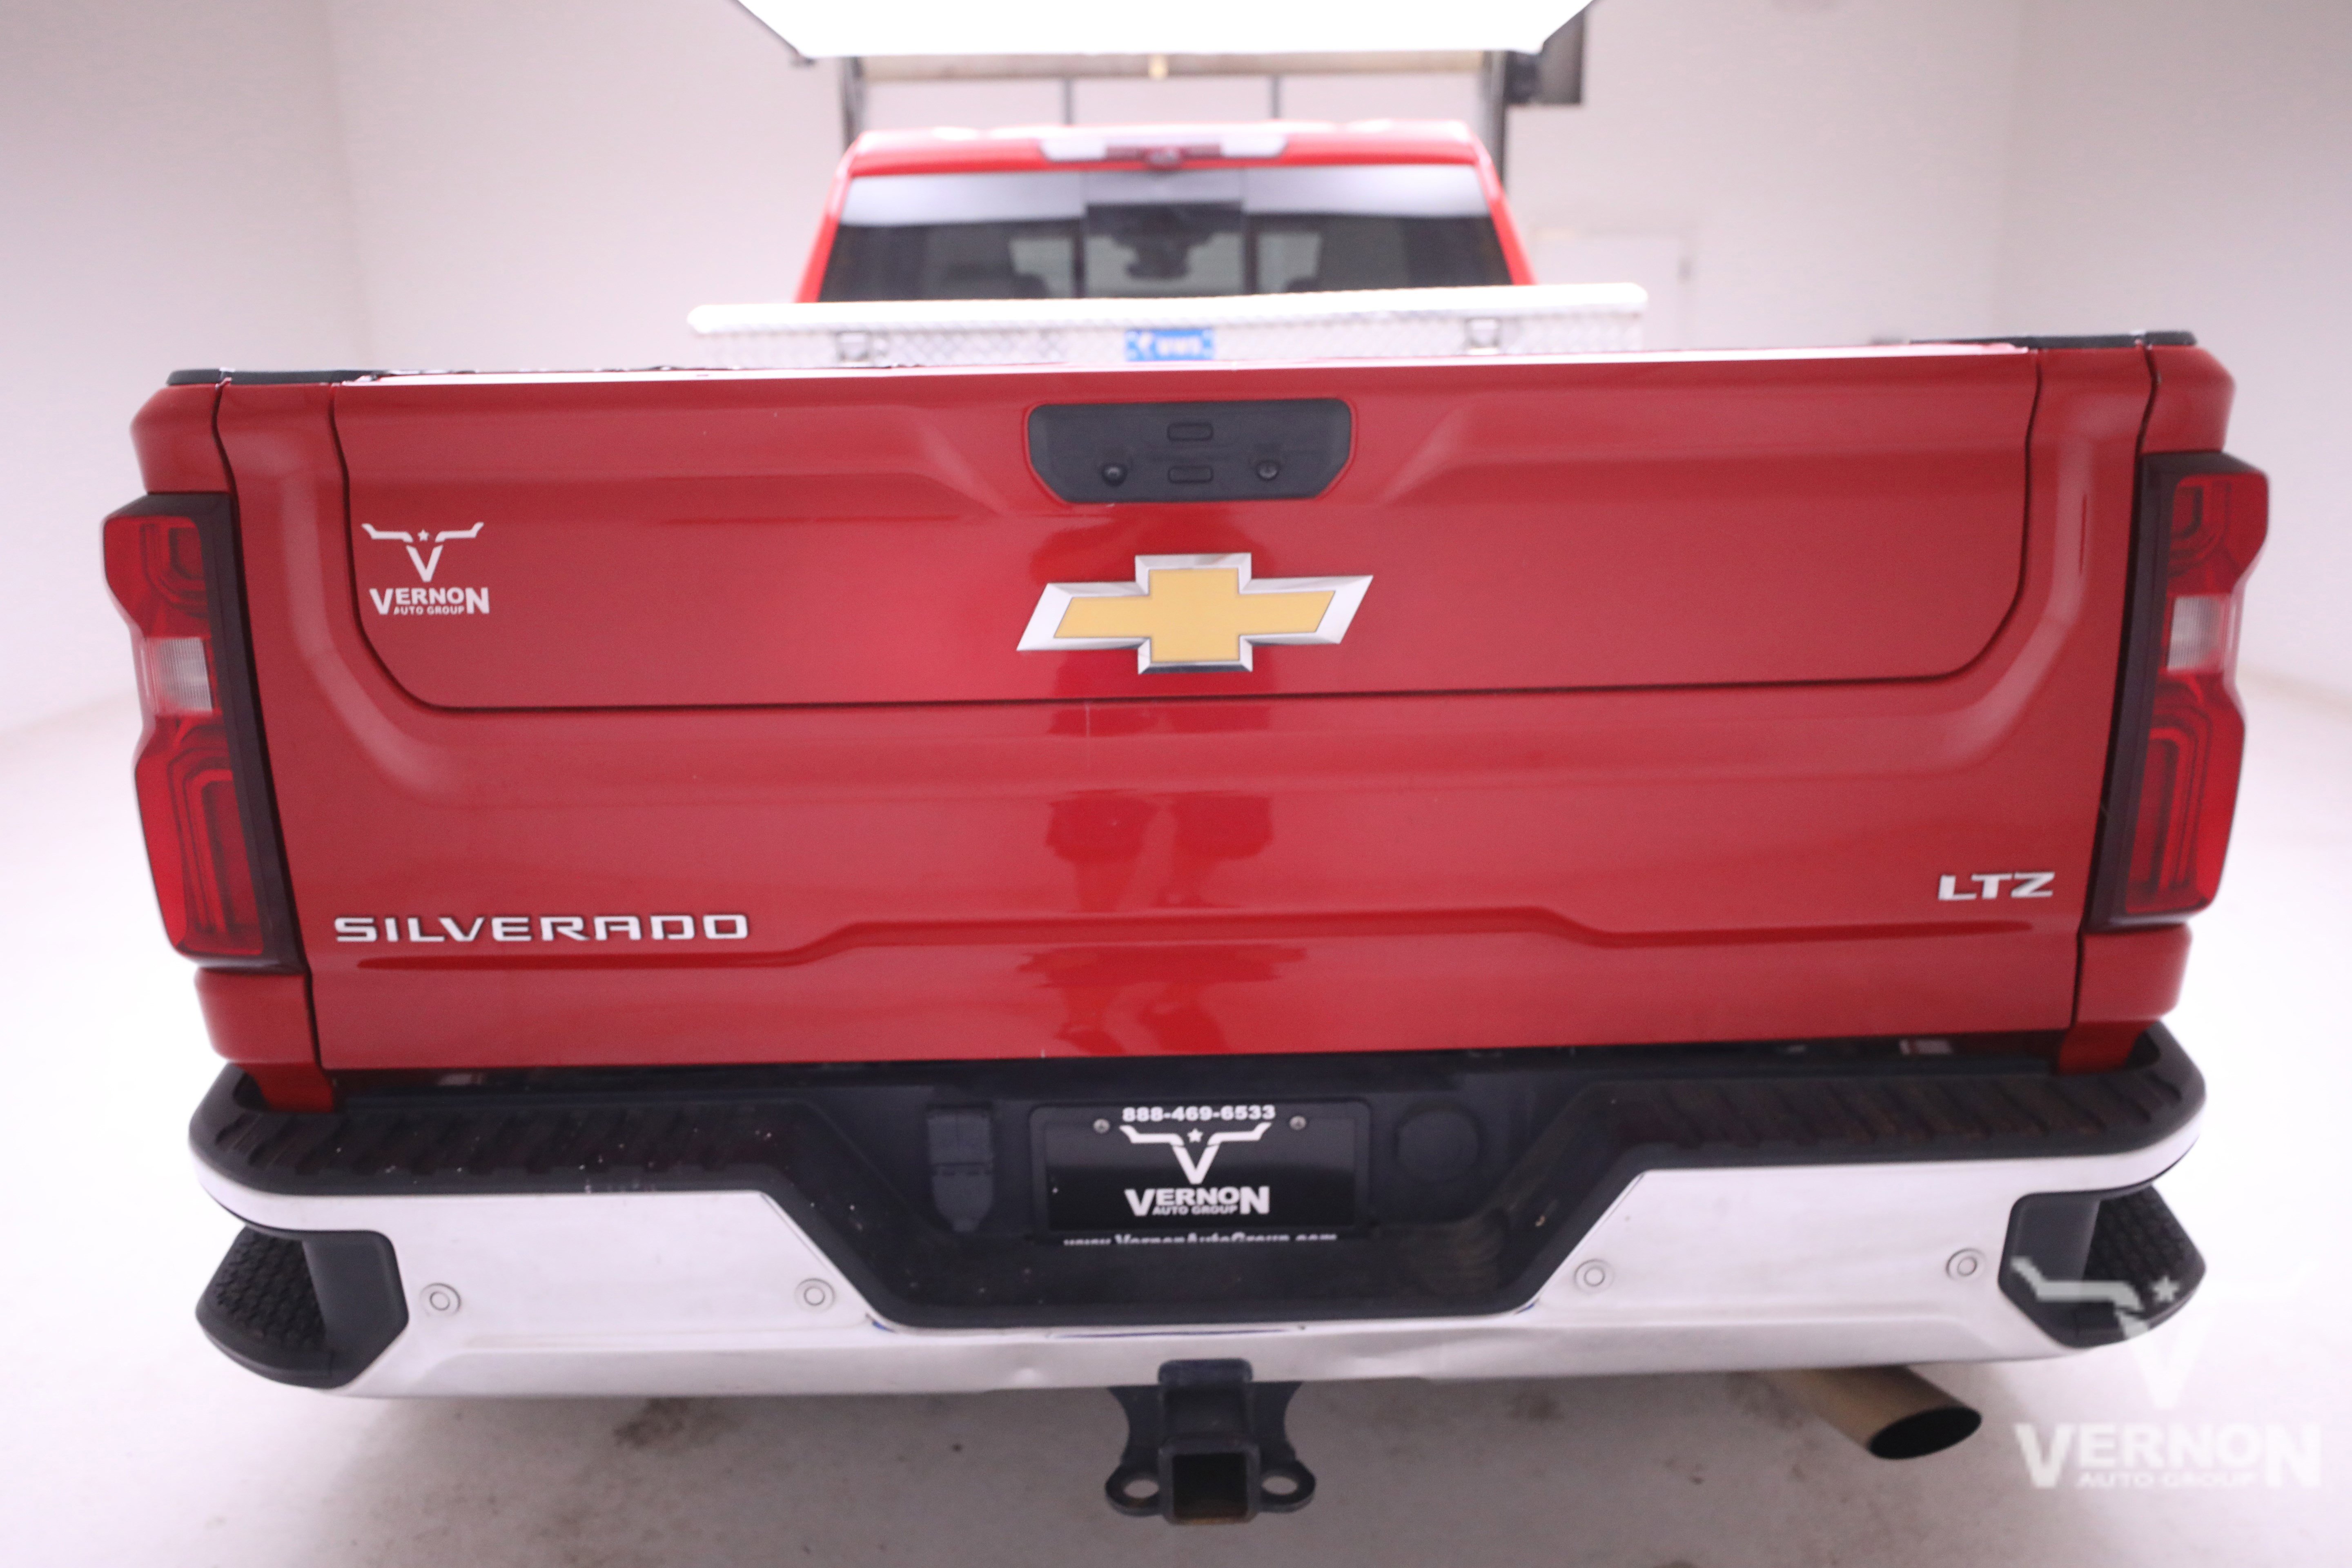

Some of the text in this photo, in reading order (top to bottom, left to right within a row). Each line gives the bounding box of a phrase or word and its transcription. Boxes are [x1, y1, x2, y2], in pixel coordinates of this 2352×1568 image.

[369, 587, 490, 615] VERNON
[393, 605, 465, 615] AUTO GROUP
[1938, 871, 2055, 900] LTZ
[334, 914, 749, 943] SILVERADO
[1122, 1105, 1275, 1122] 888-469-6533
[1124, 1186, 1270, 1216] VERNON
[1152, 1205, 1238, 1216] AUTO GROUP
[1063, 1232, 1338, 1246] wwwVernonAutoGroupcom
